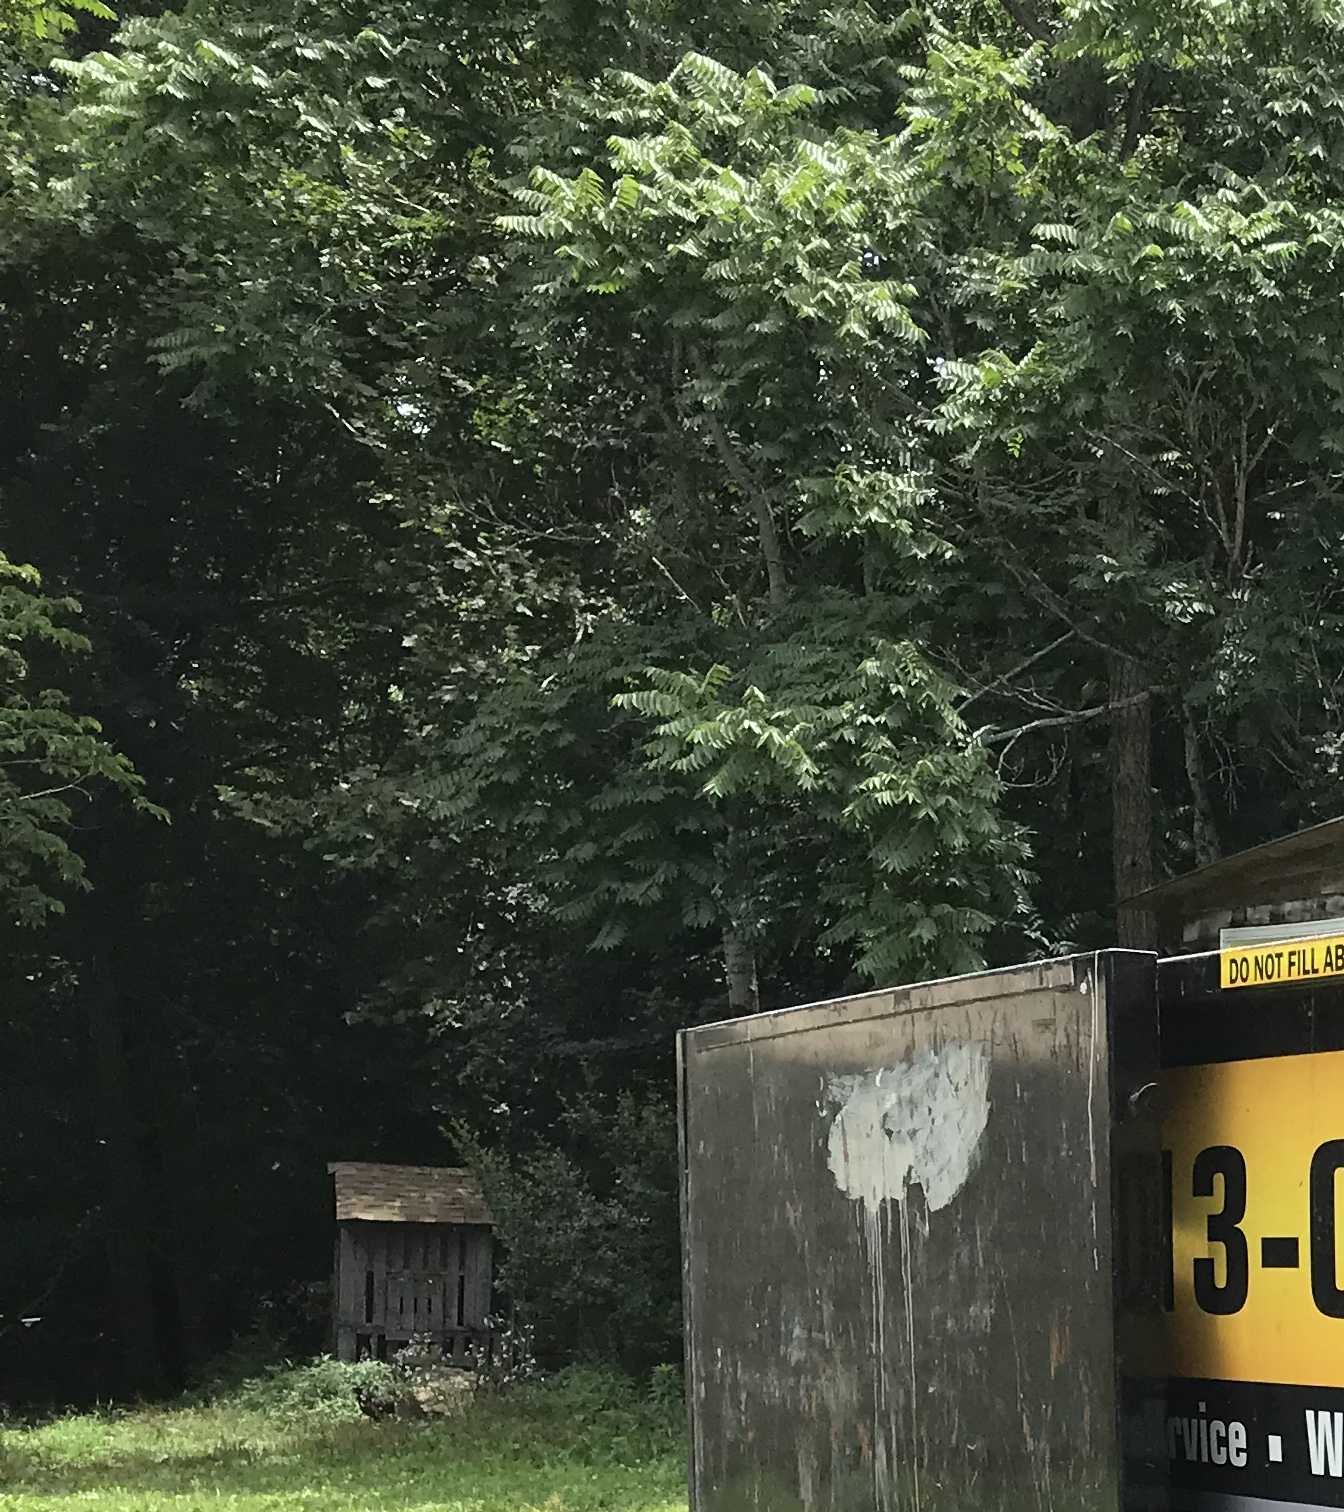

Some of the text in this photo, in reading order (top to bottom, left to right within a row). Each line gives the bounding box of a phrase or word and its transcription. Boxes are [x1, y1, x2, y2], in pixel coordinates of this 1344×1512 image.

[1229, 957, 1250, 984] DO
[1254, 952, 1284, 981] NOT
[1287, 947, 1319, 977] FILL
